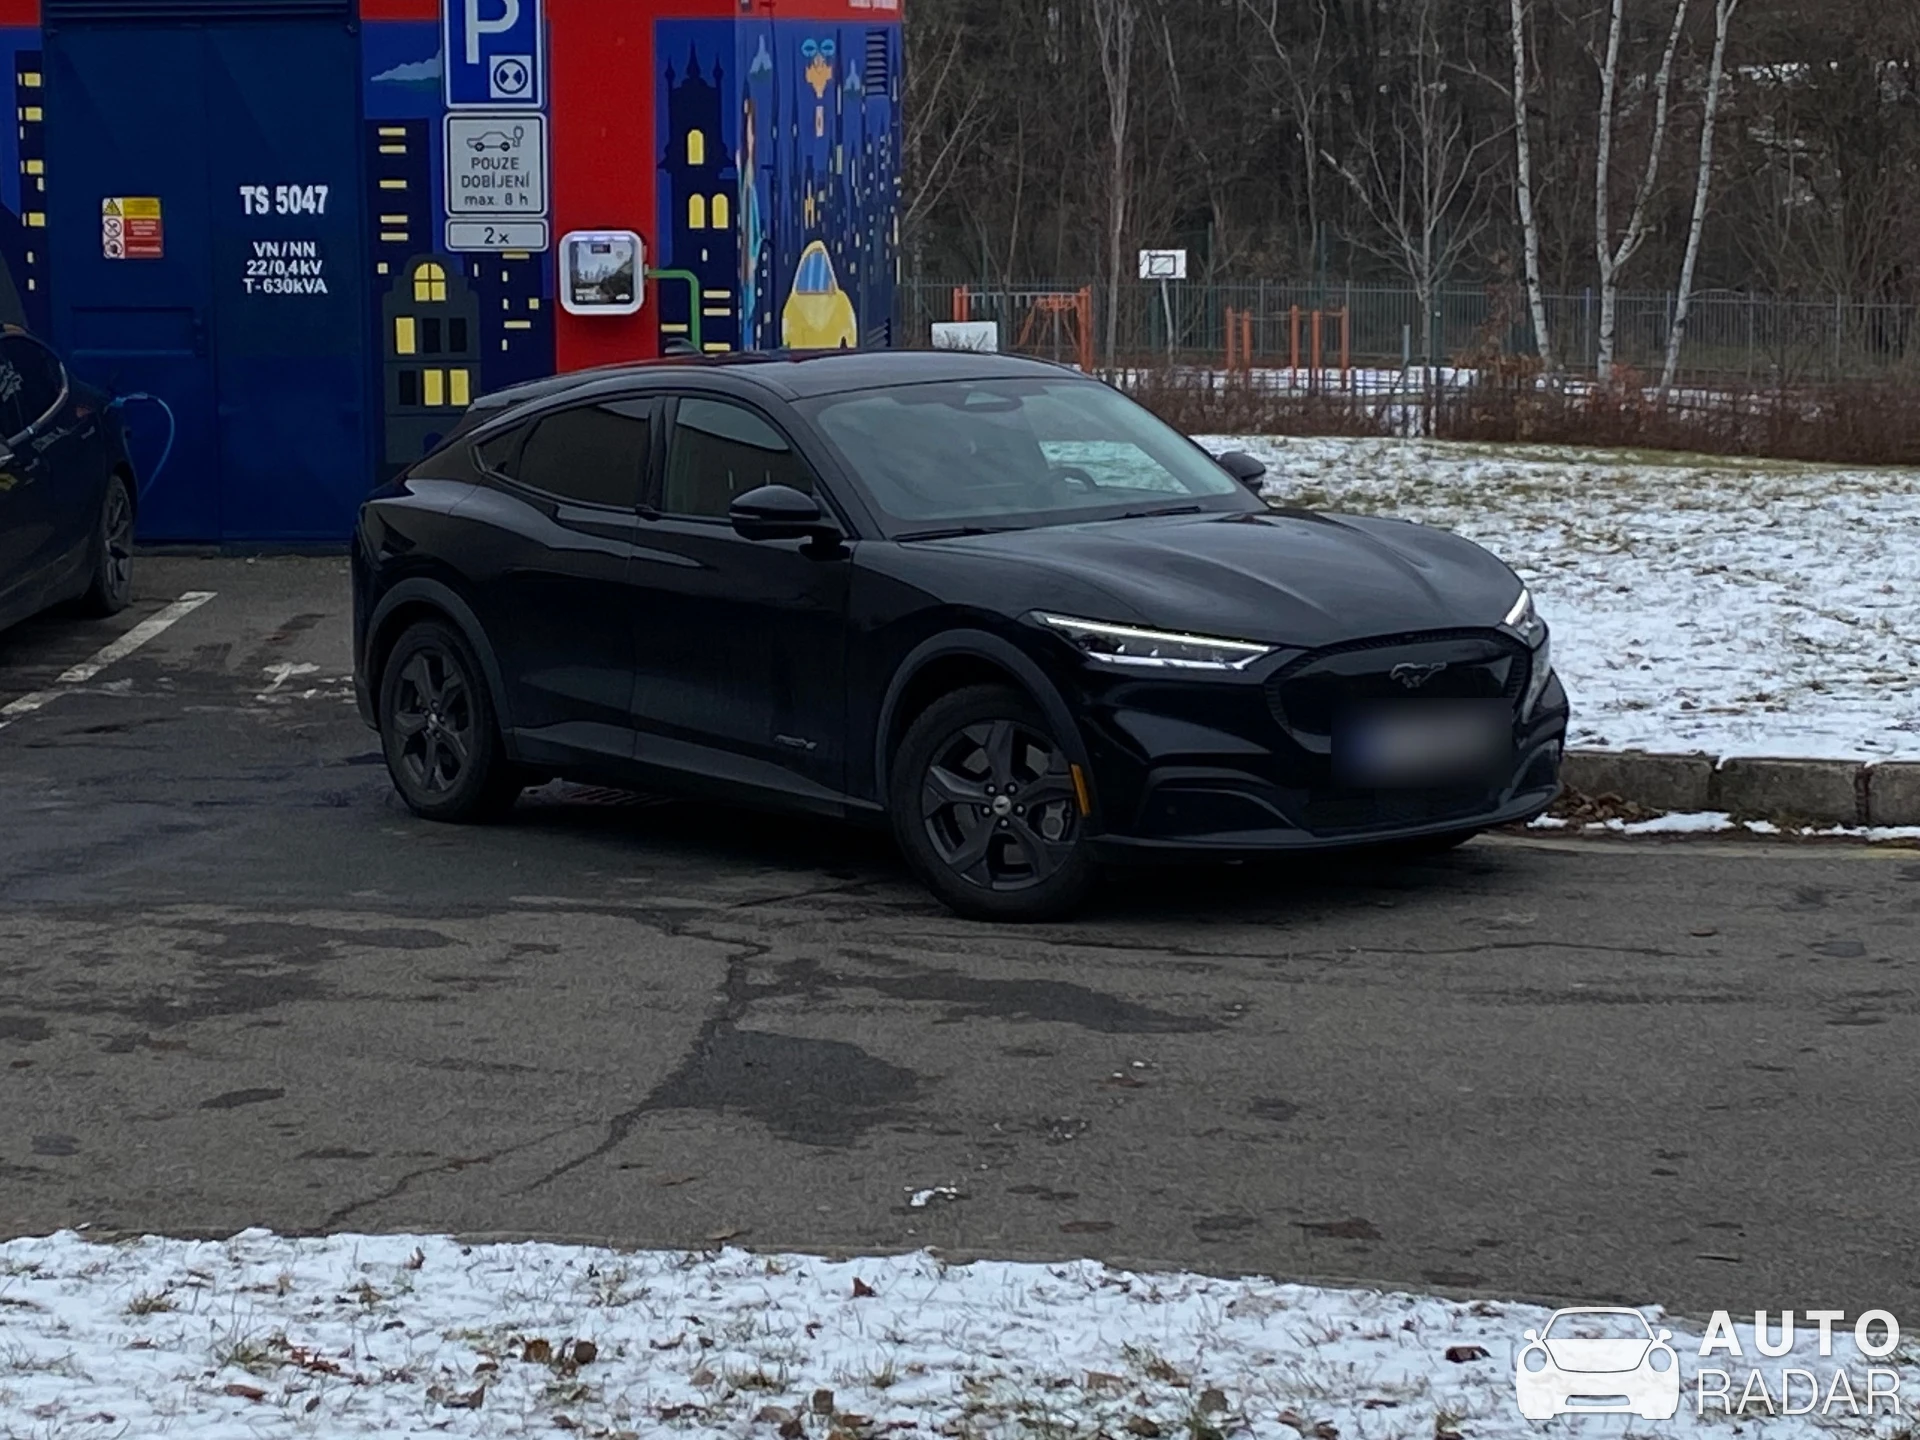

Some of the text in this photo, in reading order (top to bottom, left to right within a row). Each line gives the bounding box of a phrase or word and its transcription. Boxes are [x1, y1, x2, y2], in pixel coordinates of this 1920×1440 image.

[465, 0, 519, 65] P
[471, 157, 519, 170] POUZE
[461, 171, 530, 188] DOBÍJENÍ
[240, 184, 328, 215] TS 5047
[505, 192, 513, 206] 8
[519, 192, 529, 206] h
[484, 226, 510, 244] 2 x
[253, 241, 316, 257] VN/NN
[242, 278, 328, 294] T-630kVA
